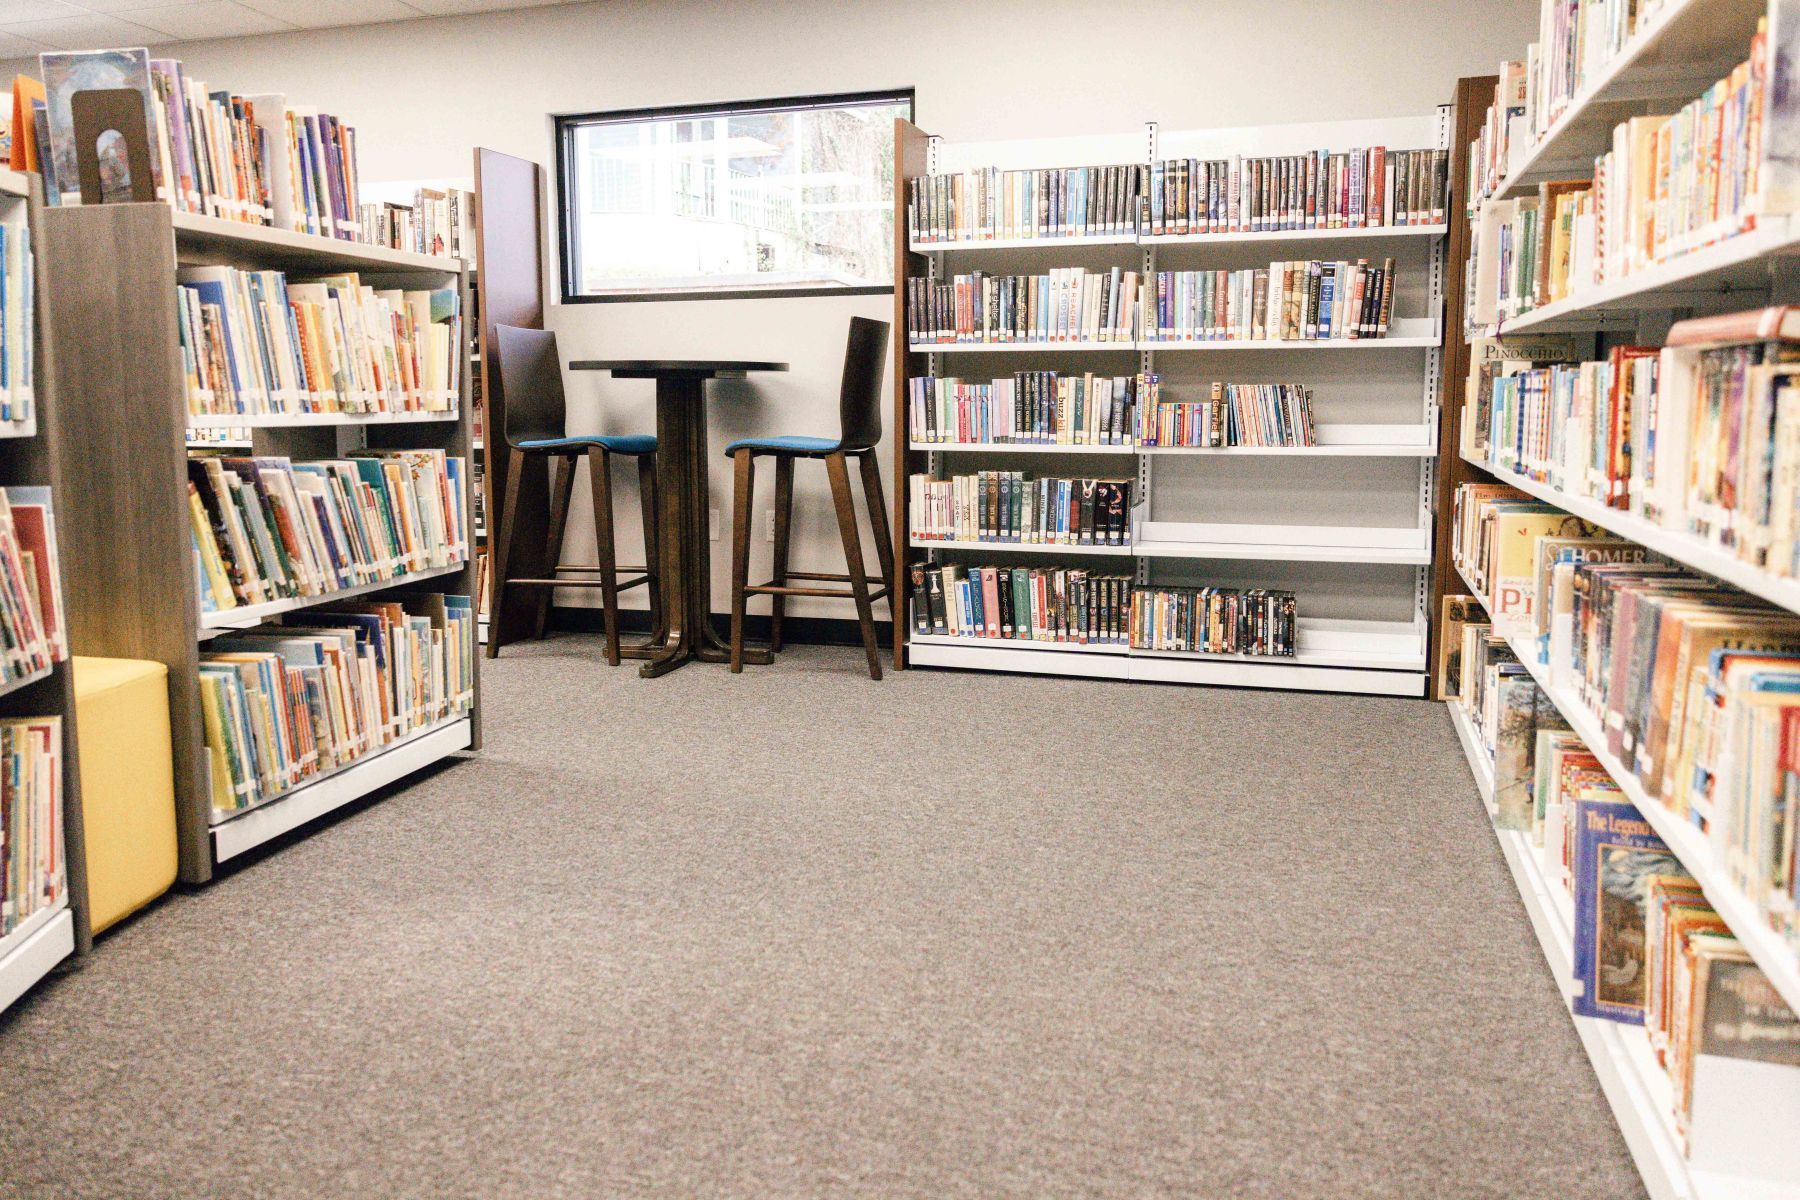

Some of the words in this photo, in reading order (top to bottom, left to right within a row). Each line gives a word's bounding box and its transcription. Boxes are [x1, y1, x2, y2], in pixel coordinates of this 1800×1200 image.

[991, 295, 999, 321] shelter
[1059, 293, 1068, 330] CROSSE
[1069, 292, 1077, 329] REACHE
[1484, 344, 1562, 359] PINOCCHIO
[1211, 400, 1220, 432] Garfiel
[1587, 811, 1607, 831] The
